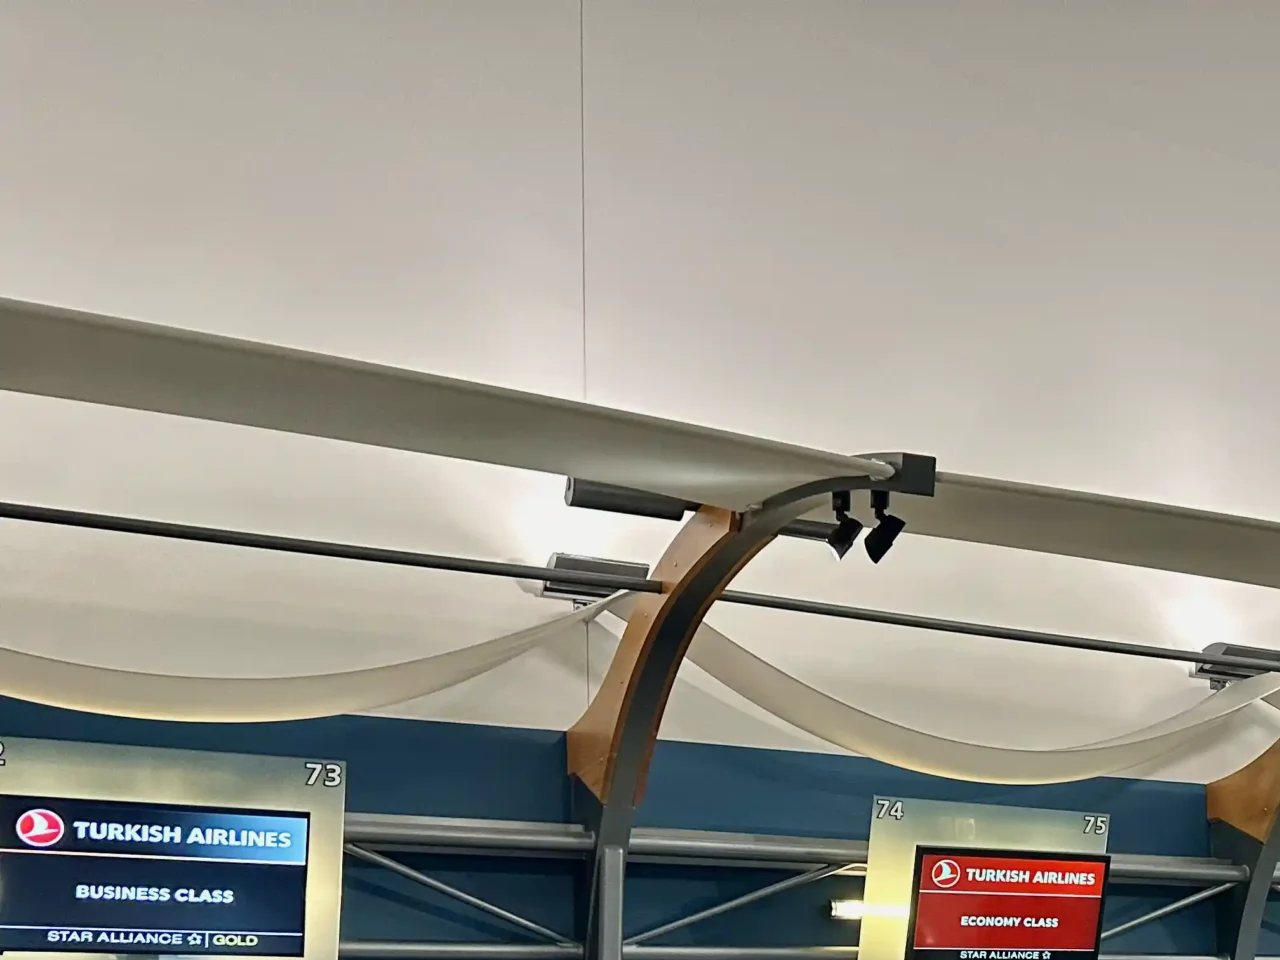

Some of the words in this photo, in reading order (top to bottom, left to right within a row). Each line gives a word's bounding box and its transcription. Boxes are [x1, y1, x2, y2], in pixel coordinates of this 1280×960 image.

[304, 763, 342, 787] 73
[876, 800, 904, 820] 74
[1083, 816, 1107, 834] 75
[73, 821, 181, 843] TURKISH
[187, 826, 291, 848] AIRLINES
[966, 868, 1029, 883] TURKISH
[1033, 871, 1095, 885] AIRLINES
[76, 885, 170, 902] BUSINESS
[175, 888, 234, 903] CLASS
[960, 915, 1021, 927] ECONOMY
[1023, 917, 1059, 928] CLASS
[47, 930, 93, 943] STAR
[97, 932, 182, 945] ALLIANCE
[212, 935, 258, 947] GOLD
[960, 950, 987, 959] STAR
[989, 951, 1039, 960] ALLIANCE
